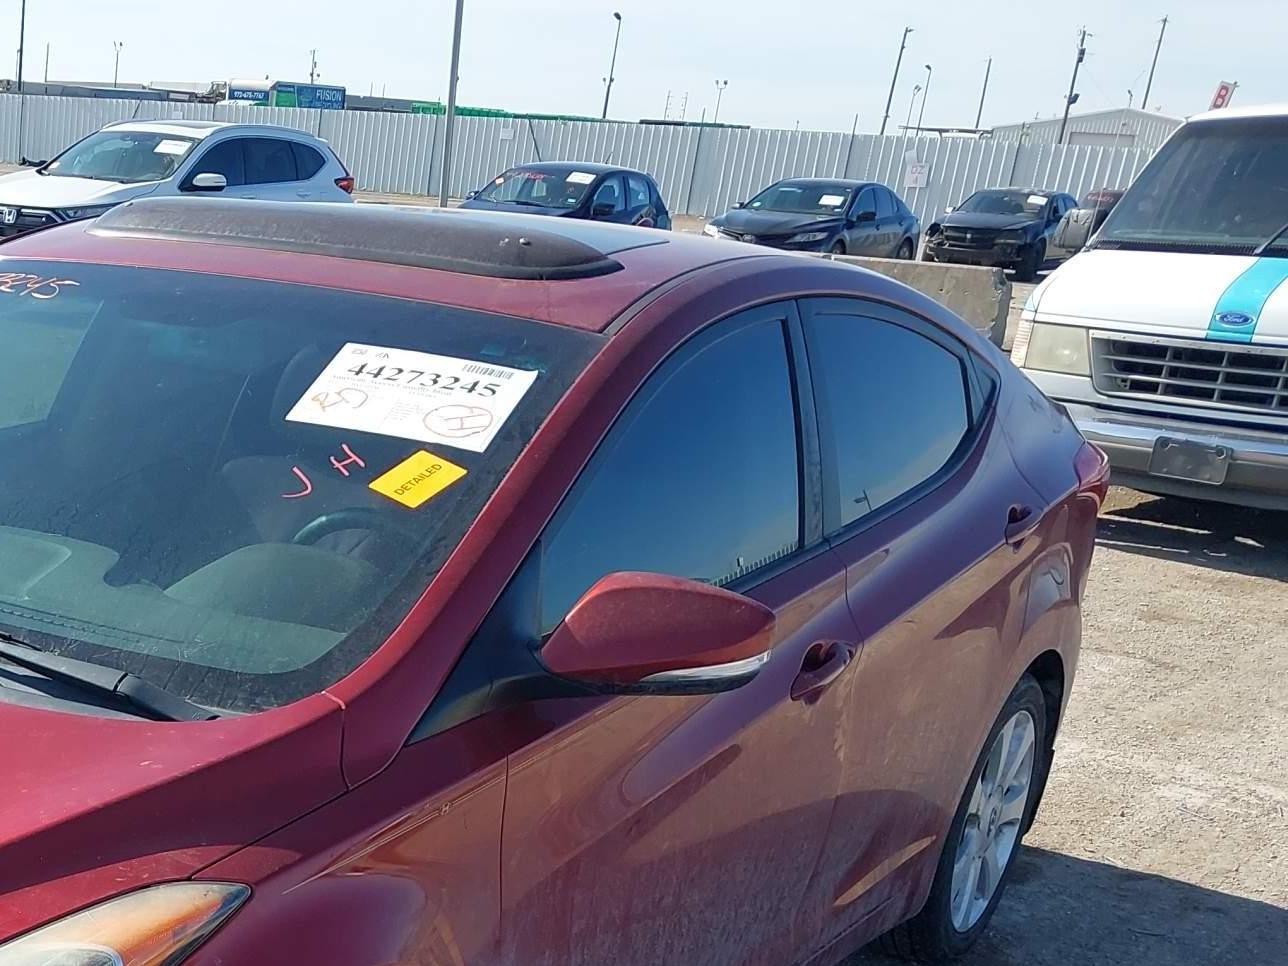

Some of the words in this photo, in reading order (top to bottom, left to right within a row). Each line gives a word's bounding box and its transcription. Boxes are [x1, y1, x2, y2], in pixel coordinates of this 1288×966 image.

[316, 88, 343, 102] FUSION
[348, 363, 502, 398] 44273245
[394, 463, 443, 497] DETAILED
